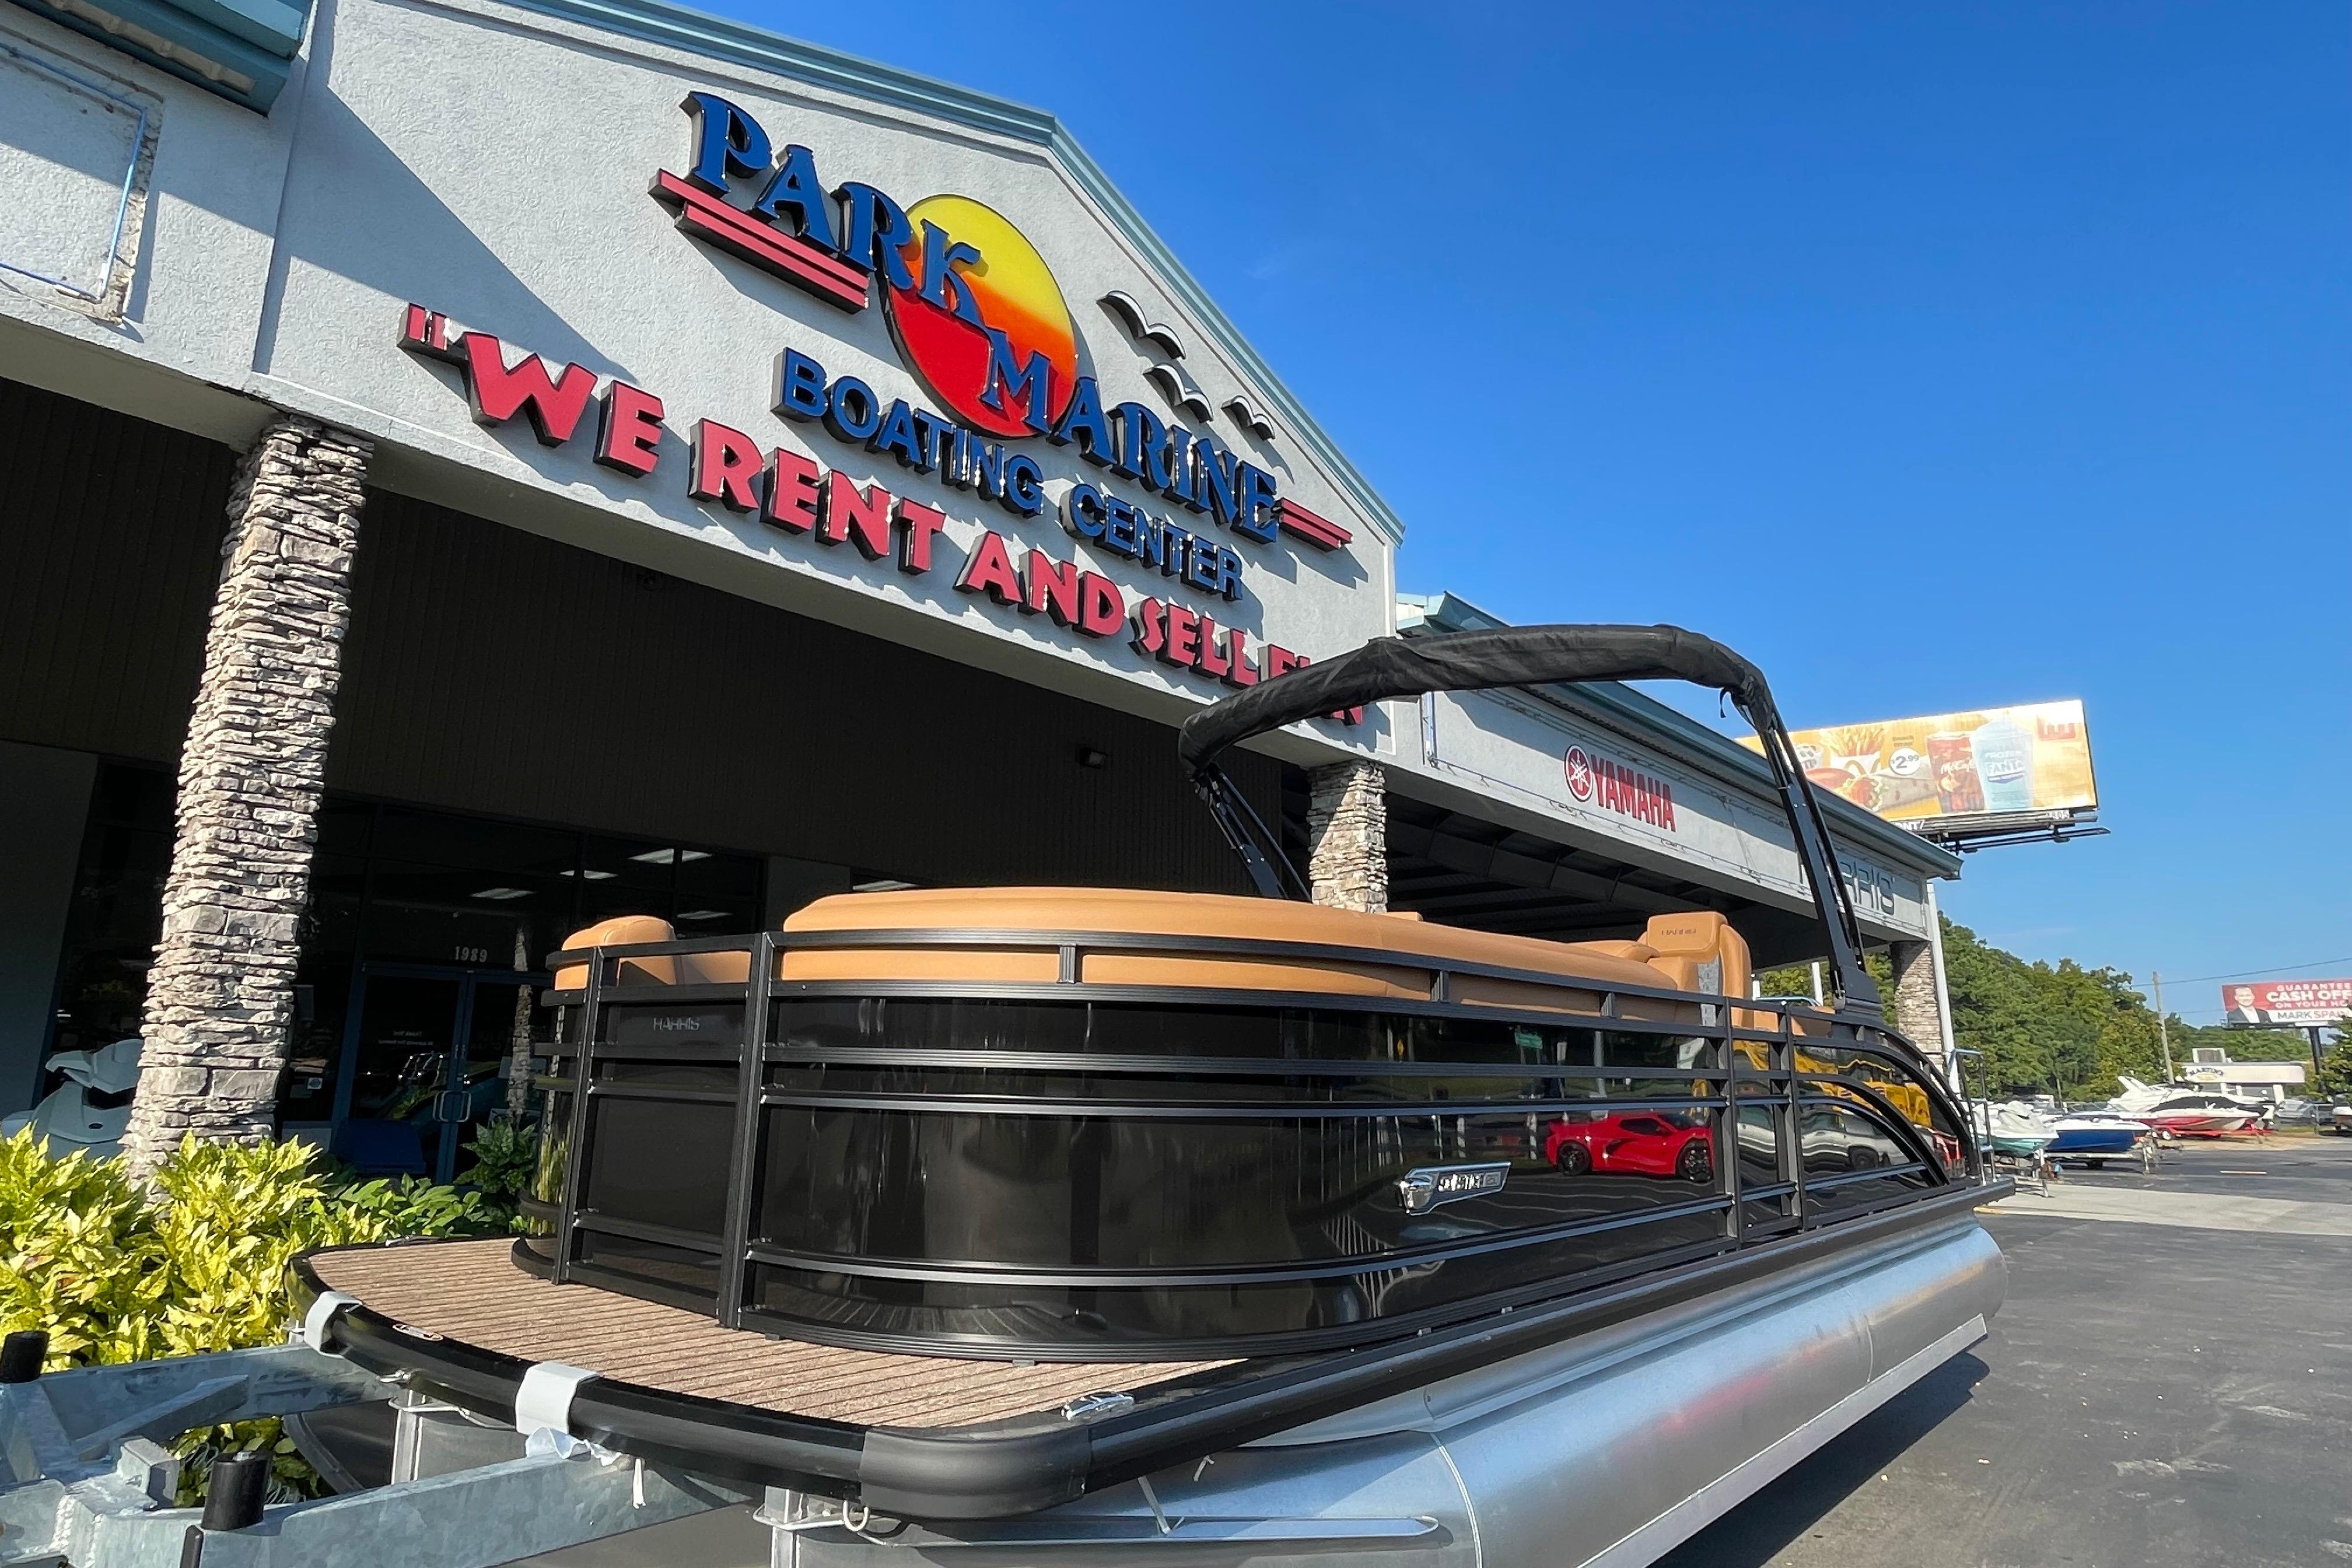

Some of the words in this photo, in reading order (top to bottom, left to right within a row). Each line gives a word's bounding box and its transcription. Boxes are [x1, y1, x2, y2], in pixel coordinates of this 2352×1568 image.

[680, 91, 987, 328] PARK
[980, 325, 1278, 543] MARINE
[774, 347, 1044, 516] BOATING
[1065, 483, 1242, 600] CENTER
[692, 418, 946, 573] RENT
[960, 531, 1125, 636] AND
[1133, 596, 1258, 687] SELL
[1591, 754, 1676, 832] YAMAHA
[454, 946, 488, 963] 1989
[2266, 991, 2314, 1002] CASH
[2277, 1010, 2312, 1020] MARK
[2295, 1000, 2326, 1008] YOUR
